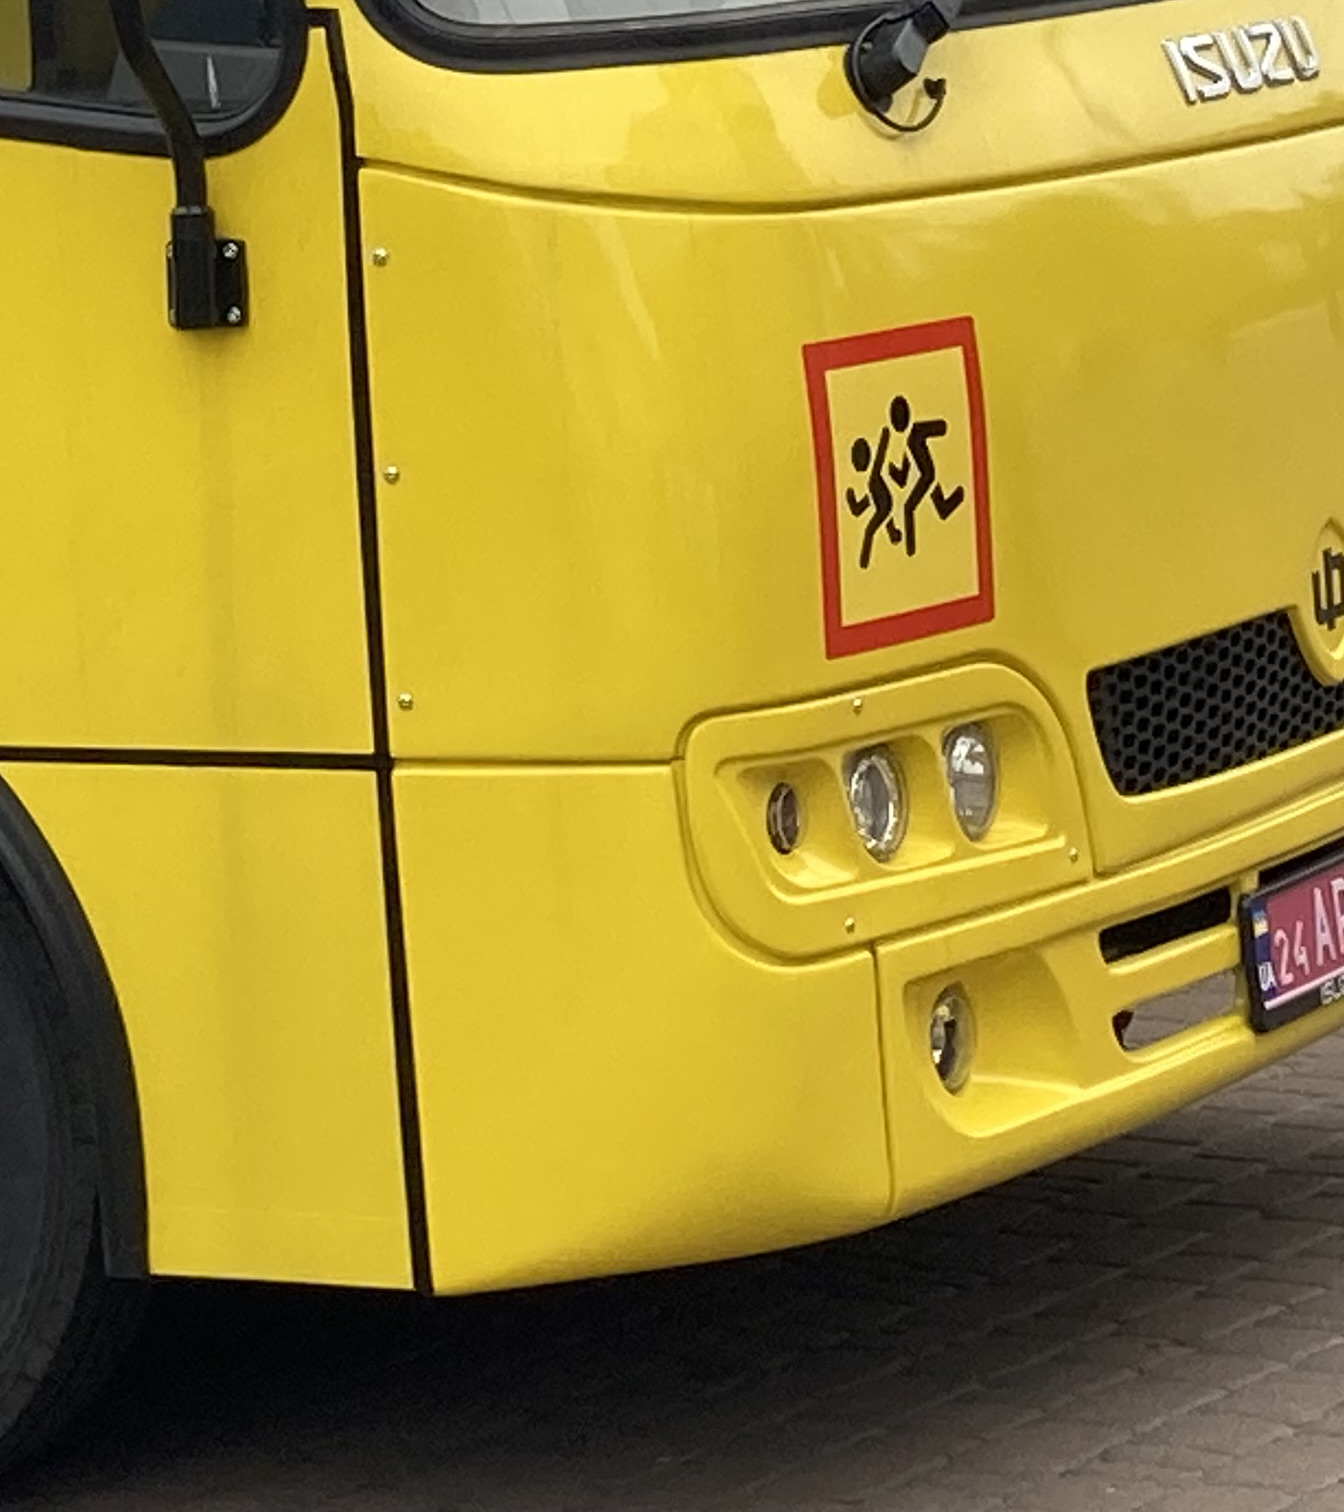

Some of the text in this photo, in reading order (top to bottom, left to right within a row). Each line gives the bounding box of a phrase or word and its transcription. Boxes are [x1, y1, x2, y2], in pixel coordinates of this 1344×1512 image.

[1160, 14, 1321, 106] ISUZU
[1258, 960, 1277, 992] UA
[1273, 919, 1311, 986] 24
